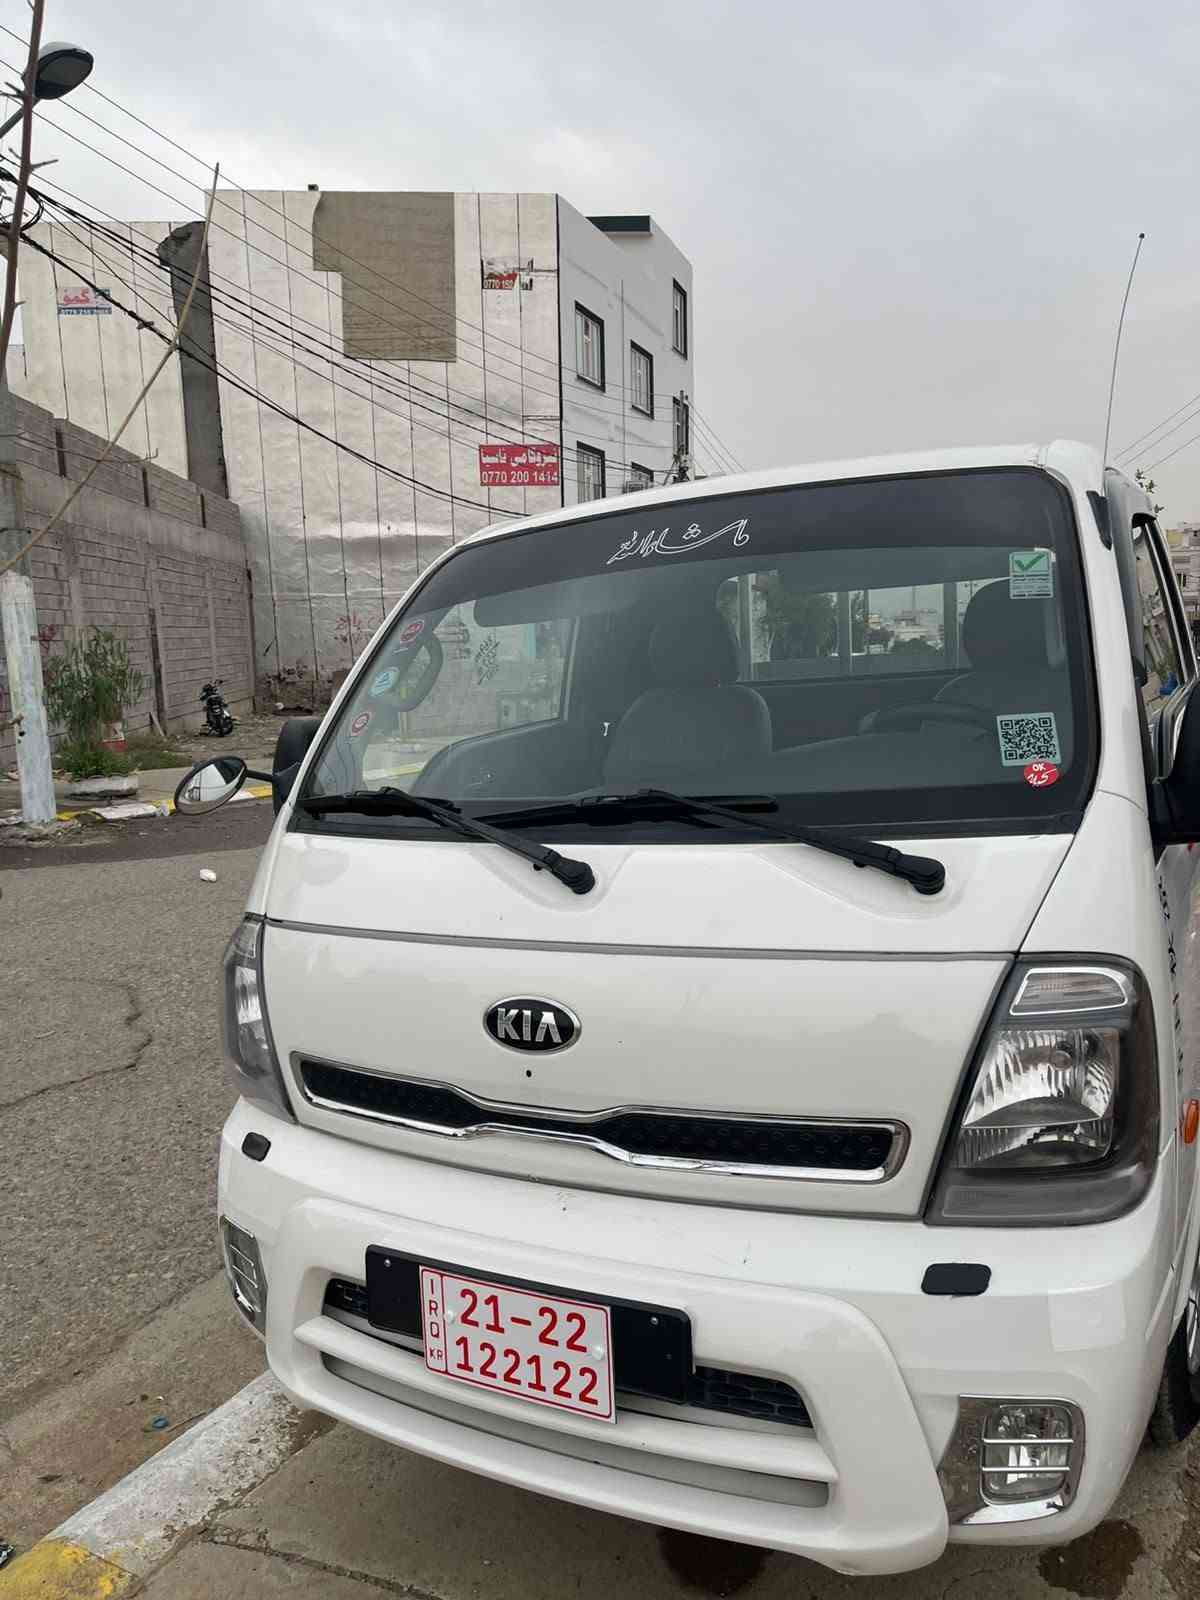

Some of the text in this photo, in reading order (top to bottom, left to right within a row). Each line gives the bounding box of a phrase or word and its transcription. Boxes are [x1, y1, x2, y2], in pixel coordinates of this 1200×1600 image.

[481, 471, 507, 483] 0770
[510, 471, 529, 483] 200
[1032, 763, 1046, 771] OK
[497, 1007, 563, 1043] KIA
[459, 1288, 588, 1353] 21-22
[429, 1348, 444, 1361] KR
[455, 1336, 599, 1406] 122122
